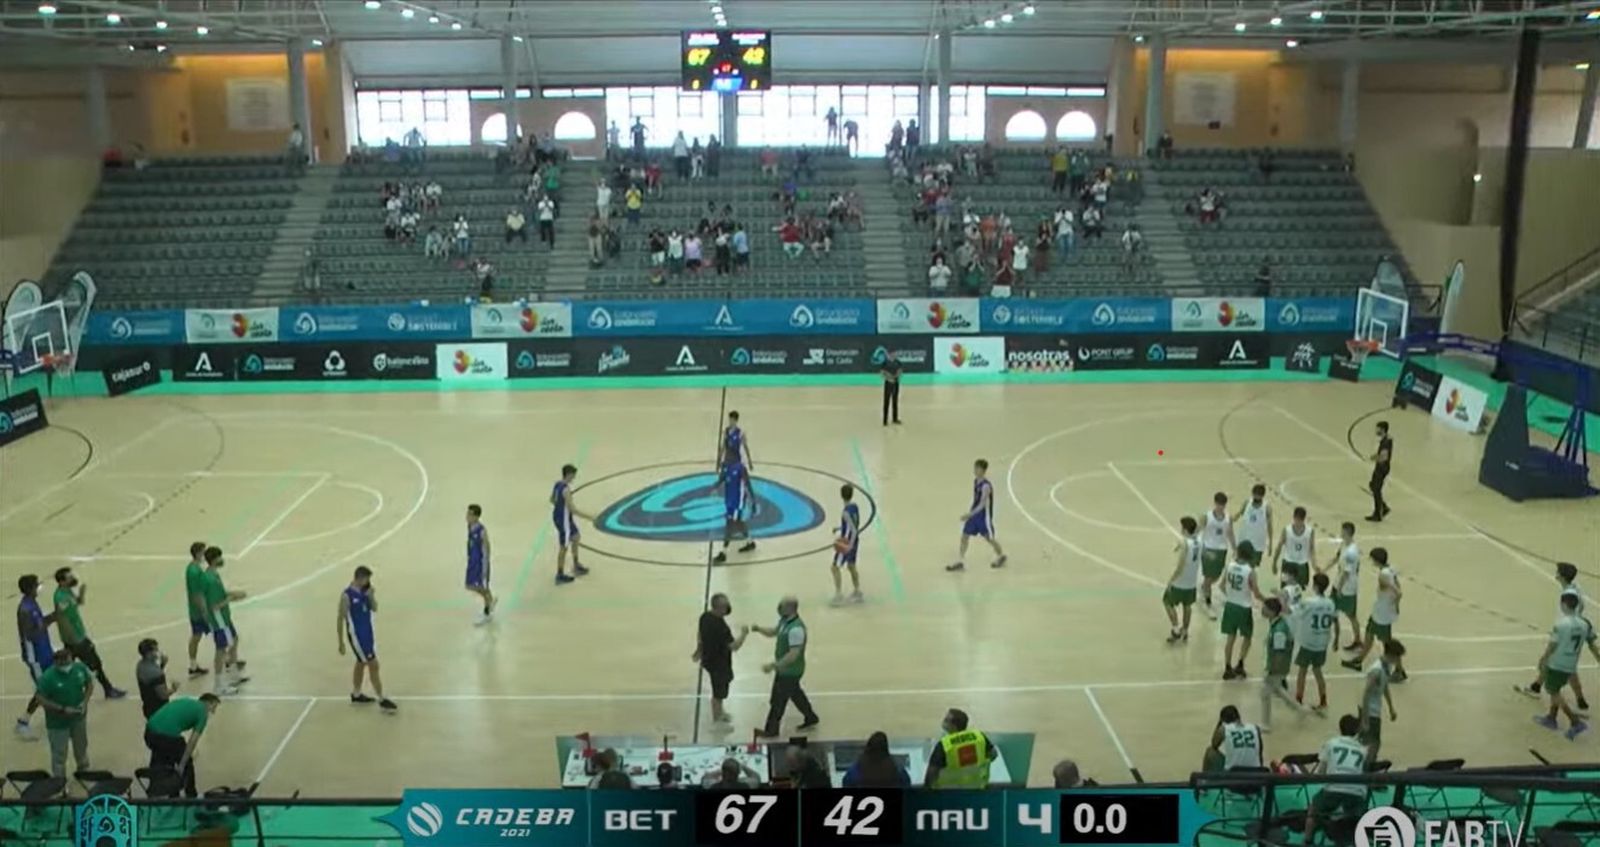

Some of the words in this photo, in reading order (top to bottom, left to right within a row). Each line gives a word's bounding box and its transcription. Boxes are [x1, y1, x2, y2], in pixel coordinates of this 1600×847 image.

[1008, 349, 1070, 361] nosotras
[1227, 572, 1244, 591] 42
[1311, 614, 1332, 630] 10
[1571, 634, 1582, 651] 7
[1231, 730, 1256, 748] 22
[1333, 747, 1364, 767] 77
